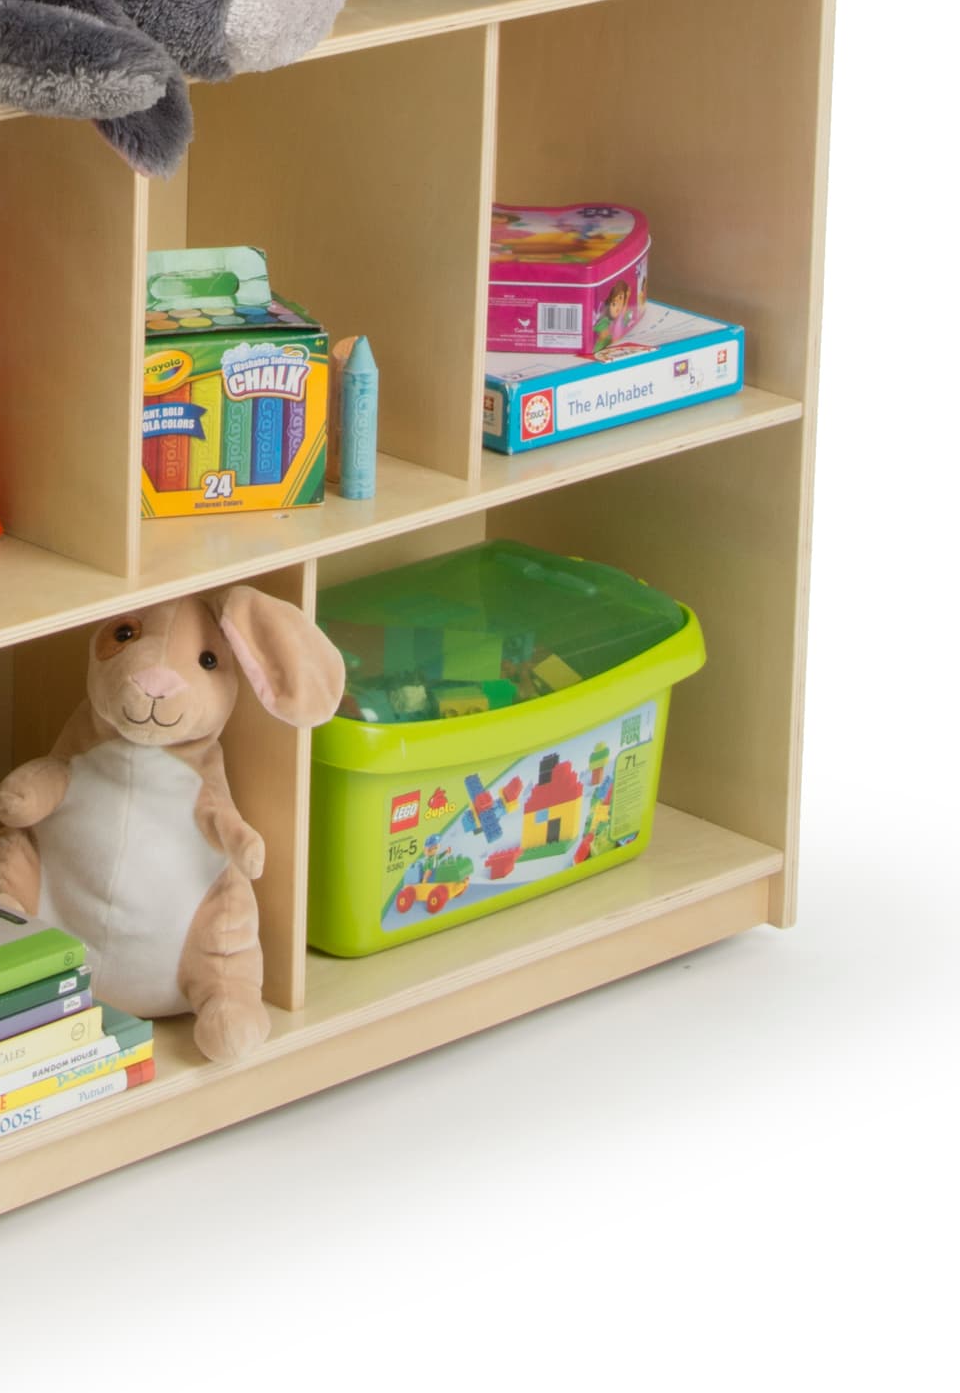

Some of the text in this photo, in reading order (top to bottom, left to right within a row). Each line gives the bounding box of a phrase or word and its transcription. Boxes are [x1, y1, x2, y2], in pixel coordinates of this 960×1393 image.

[228, 364, 308, 397] CHALK
[567, 381, 655, 416] The Alphabet
[162, 406, 185, 417] BOLD
[161, 418, 195, 430] COLORS
[204, 474, 232, 499] 24
[393, 802, 457, 821] LEGO duplo
[32, 1059, 69, 1079] RANDOM
[70, 1047, 98, 1066] HOUSE
[79, 1082, 115, 1103] Putnam
